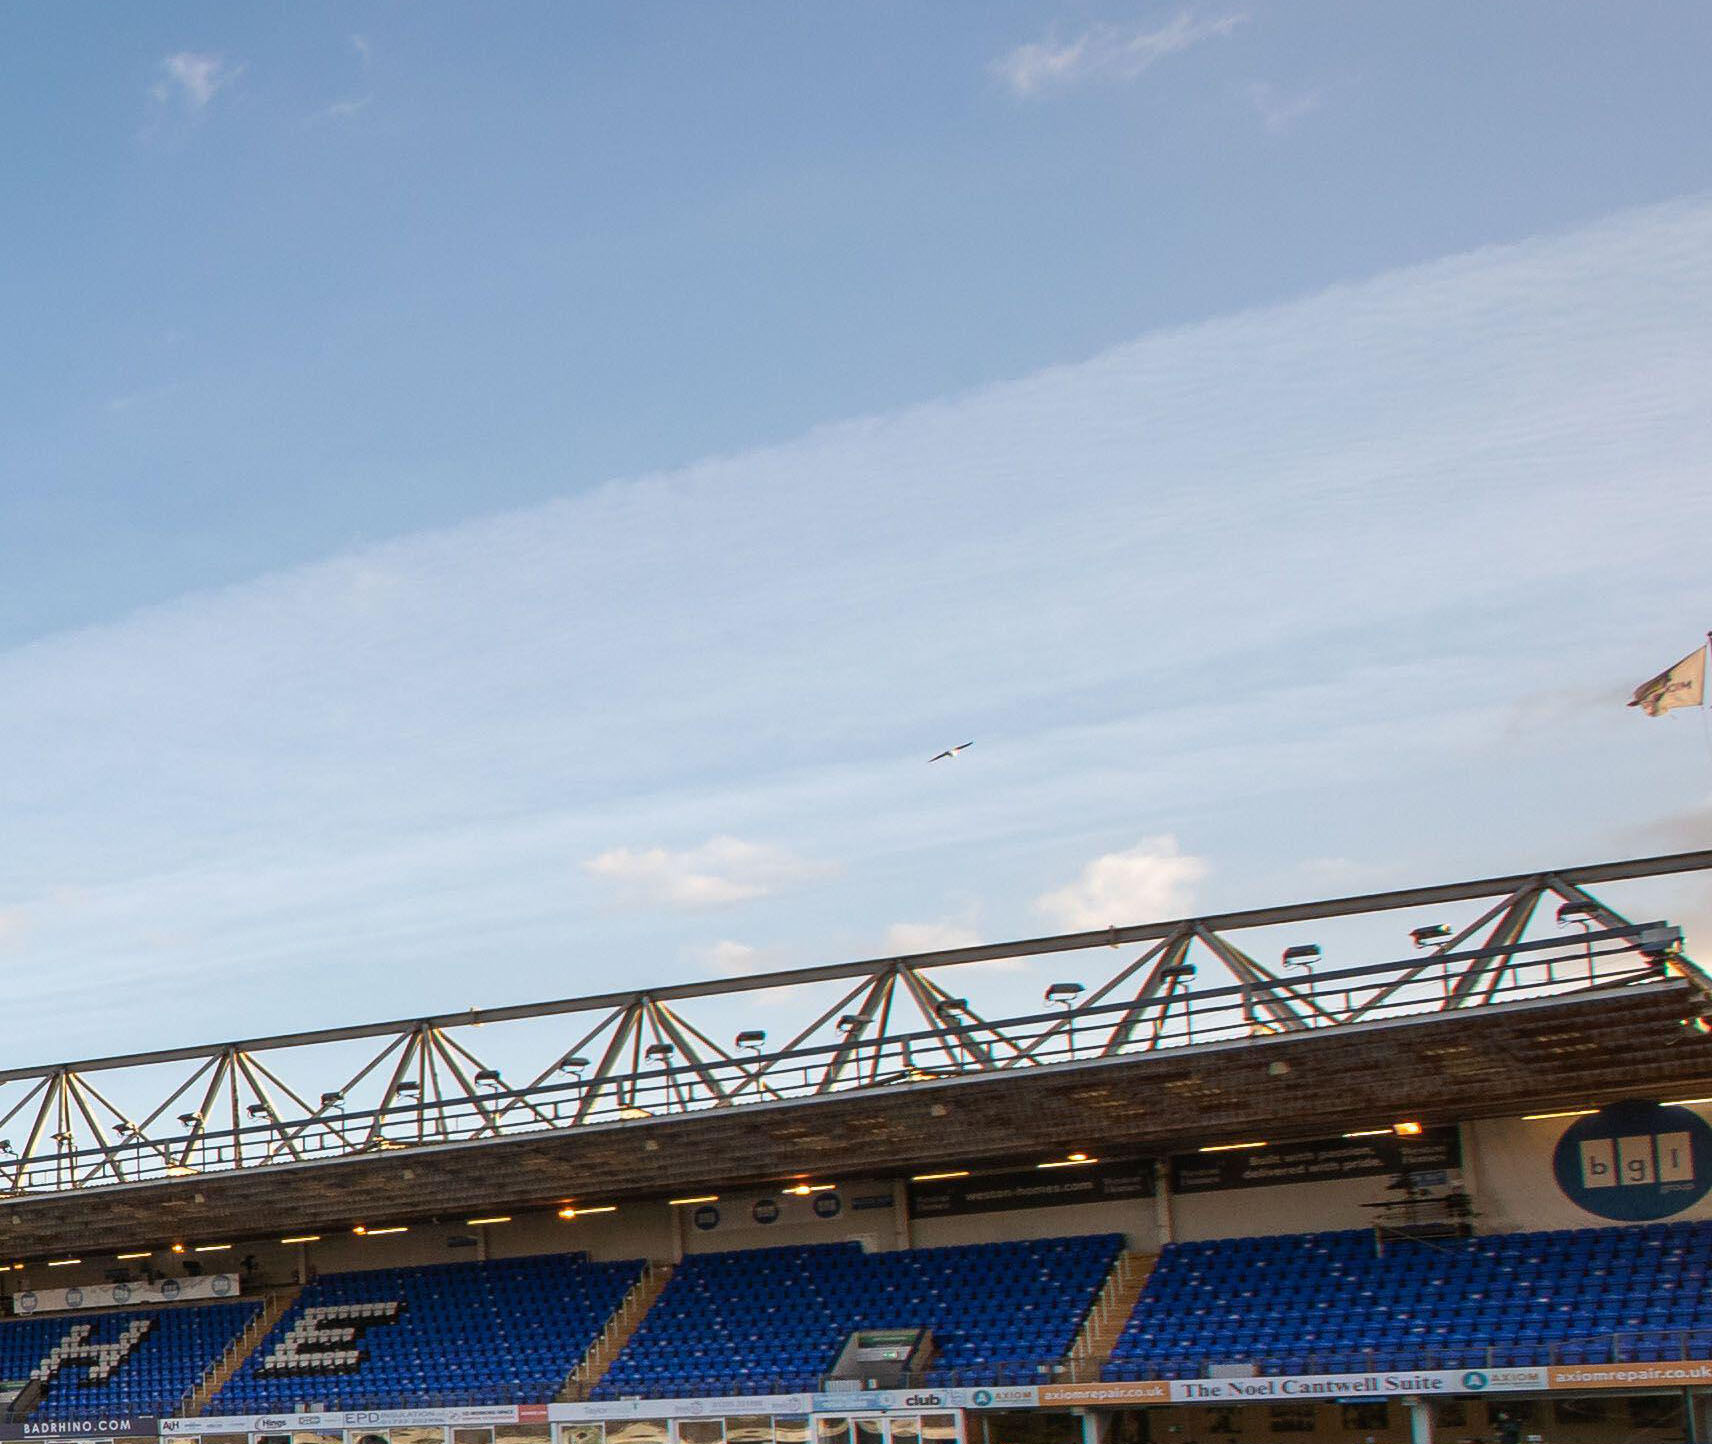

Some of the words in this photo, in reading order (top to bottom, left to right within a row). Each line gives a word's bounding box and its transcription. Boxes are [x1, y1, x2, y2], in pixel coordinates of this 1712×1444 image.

[1588, 1148, 1679, 1182] bgl
[1554, 1366, 1712, 1384] axiomrepair.co.uk
[1043, 1385, 1166, 1401] axiomrepair.co.uk
[1183, 1382, 1220, 1398] The
[1228, 1380, 1275, 1396] Noel
[1281, 1377, 1378, 1395] Cantwell
[1384, 1375, 1444, 1391] Suite
[905, 1393, 942, 1406] club
[345, 1411, 380, 1424] EPD
[23, 1419, 132, 1434] BADRHINO.COM
